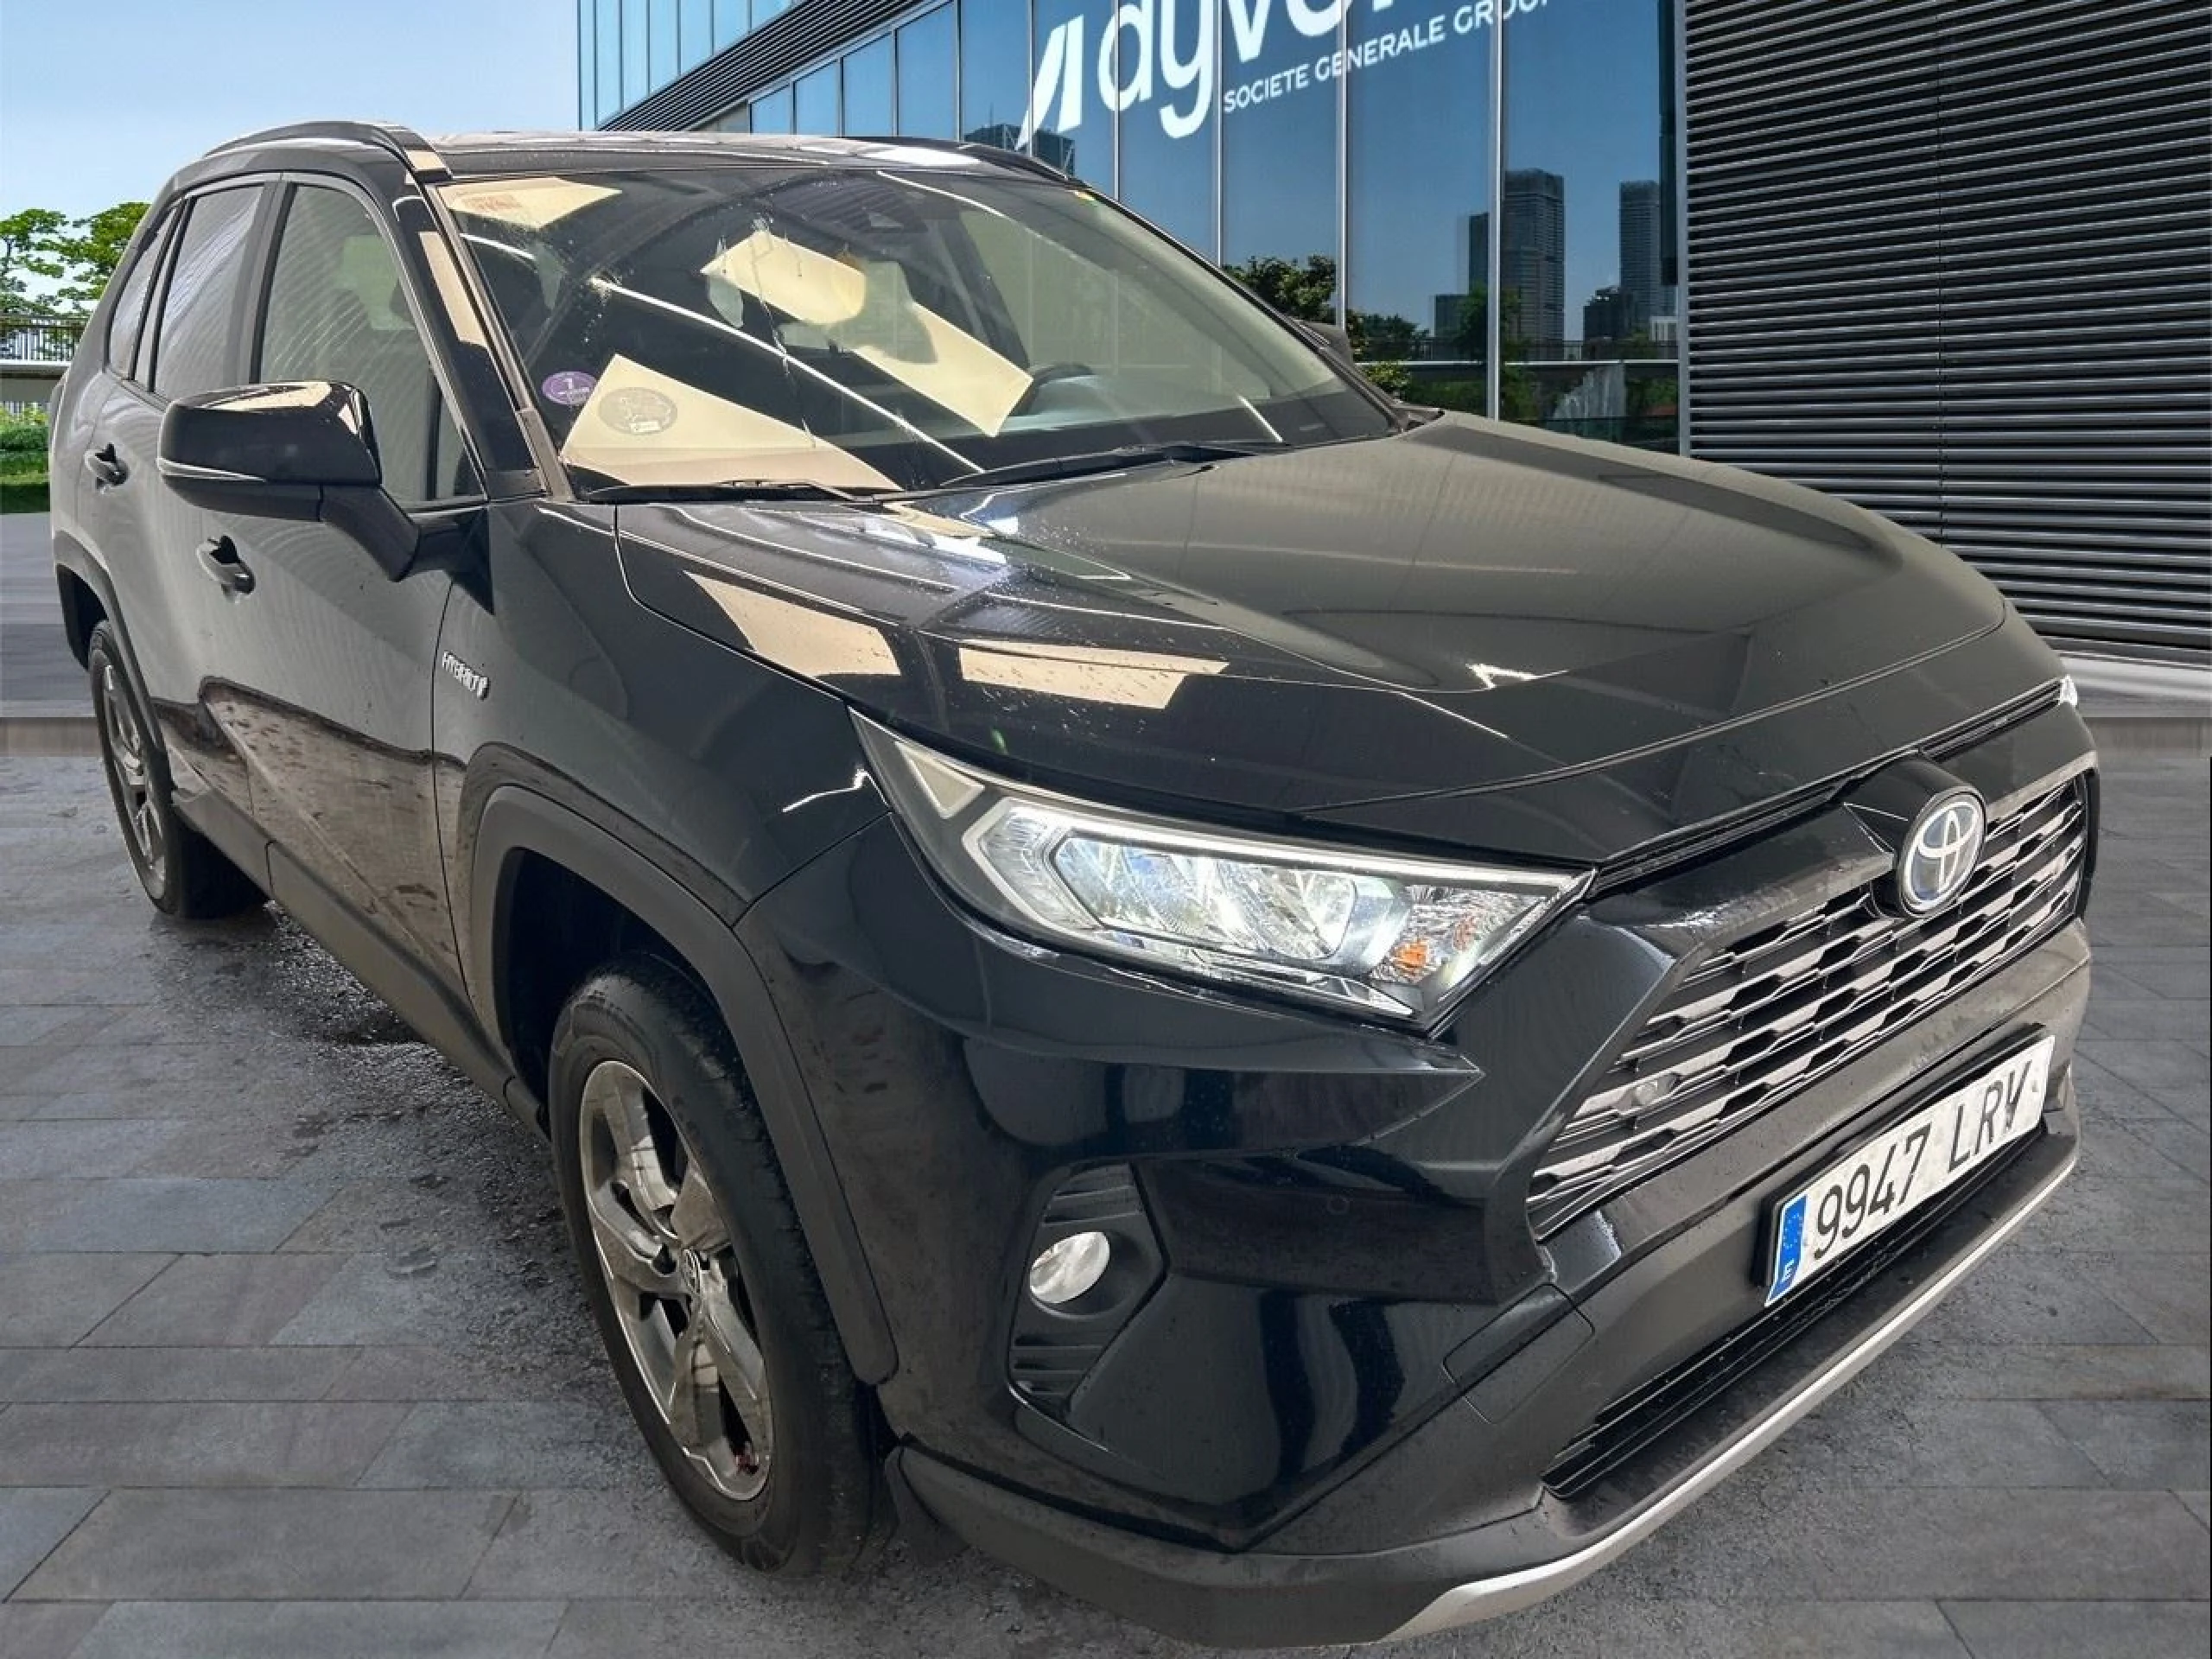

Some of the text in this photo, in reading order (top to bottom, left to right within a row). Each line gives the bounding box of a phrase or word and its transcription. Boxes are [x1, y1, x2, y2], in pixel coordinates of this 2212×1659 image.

[1223, 64, 1309, 113] SOCIETE
[1314, 15, 1446, 82] GENERALE
[442, 651, 488, 697] HYBRID
[1815, 1059, 2032, 1260] 9947 LRV
